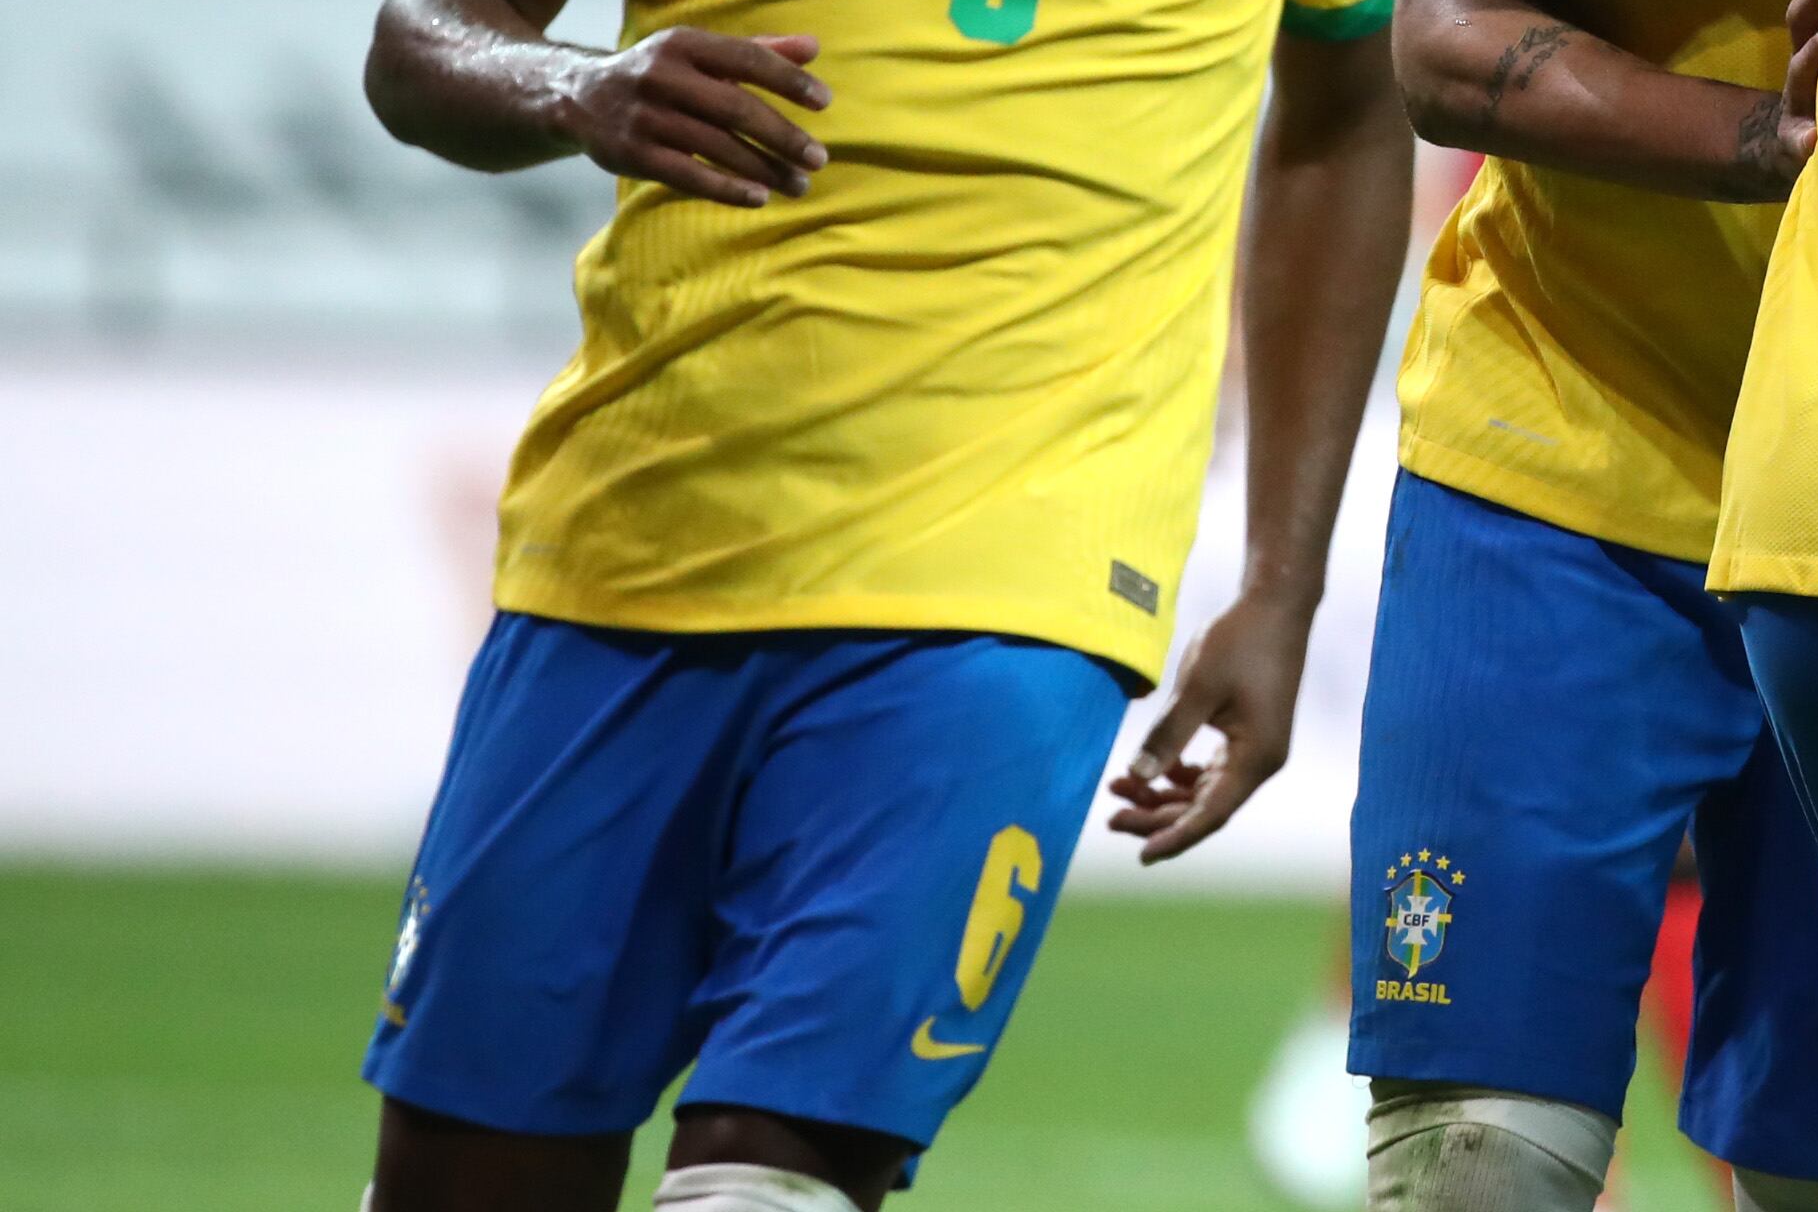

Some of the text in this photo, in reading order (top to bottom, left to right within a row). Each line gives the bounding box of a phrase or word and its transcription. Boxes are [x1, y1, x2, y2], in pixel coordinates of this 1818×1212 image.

[955, 824, 1043, 1012] 6
[1403, 913, 1430, 927] CBF
[1376, 979, 1451, 1005] BRASIL
